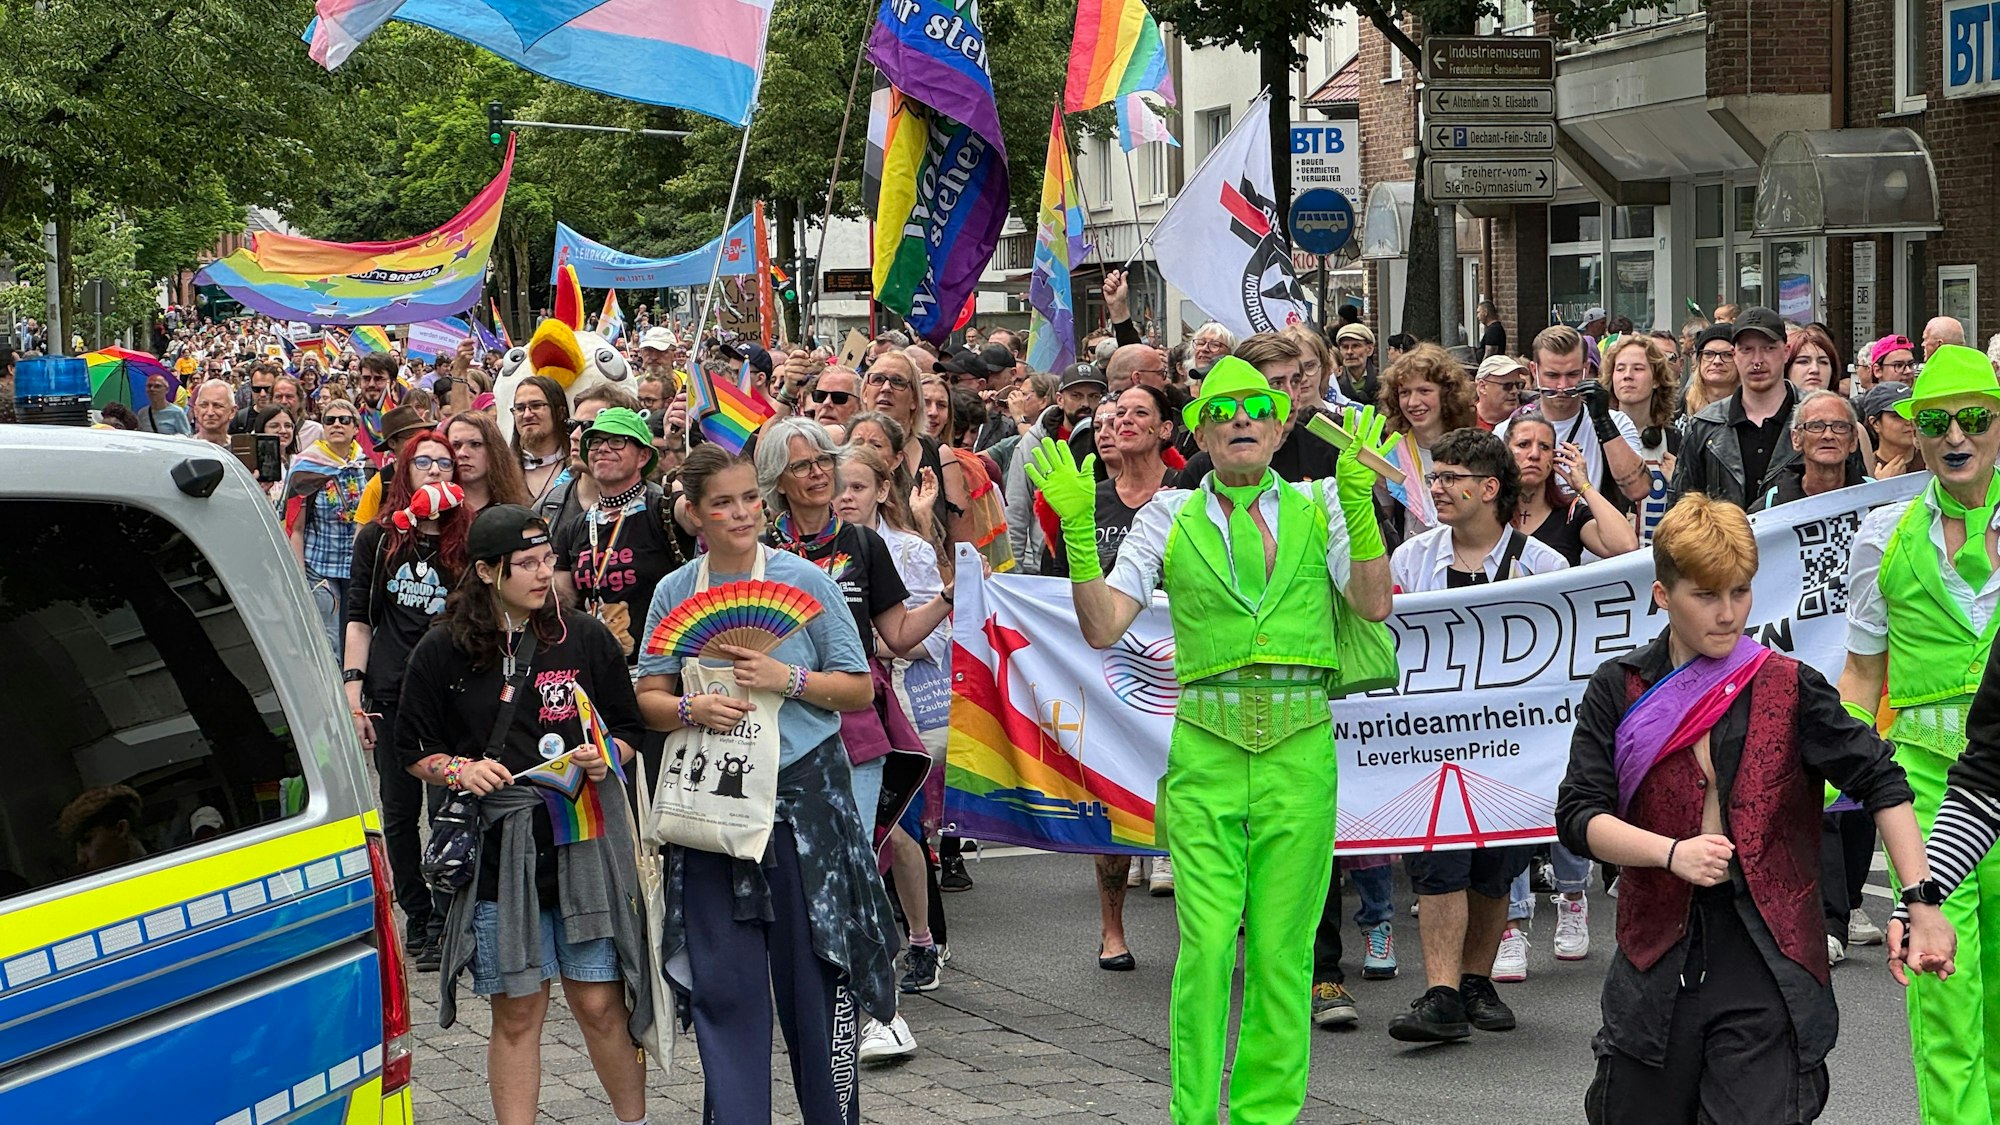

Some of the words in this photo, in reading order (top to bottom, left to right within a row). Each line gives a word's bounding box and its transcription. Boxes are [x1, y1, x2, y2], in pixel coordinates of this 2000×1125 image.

[1950, 2, 2000, 87] BT
[1448, 44, 1541, 59] Industriemuseum
[1449, 63, 1493, 74] Freudenthaler
[1452, 95, 1489, 108] Altenheim
[1492, 95, 1503, 108] St.
[1505, 95, 1539, 108] Elisabeth
[1290, 127, 1345, 154] BTB
[1470, 131, 1547, 144] Dechant-Fein-Straße
[1301, 158, 1324, 166] BAUEN
[1301, 167, 1340, 175] VERMIETEN
[1461, 165, 1532, 178] Freiherr-vom-
[1301, 175, 1342, 183] VERWALTEN
[1444, 181, 1532, 195] Stein-Gymnasium
[1782, 207, 1791, 222] 19
[577, 547, 634, 569] Free
[399, 579, 435, 597] PROUD
[396, 592, 431, 609] PUPPY
[843, 595, 863, 603] kusen
[915, 693, 932, 703] aus
[1357, 739, 1520, 767] LeverkusenPride
